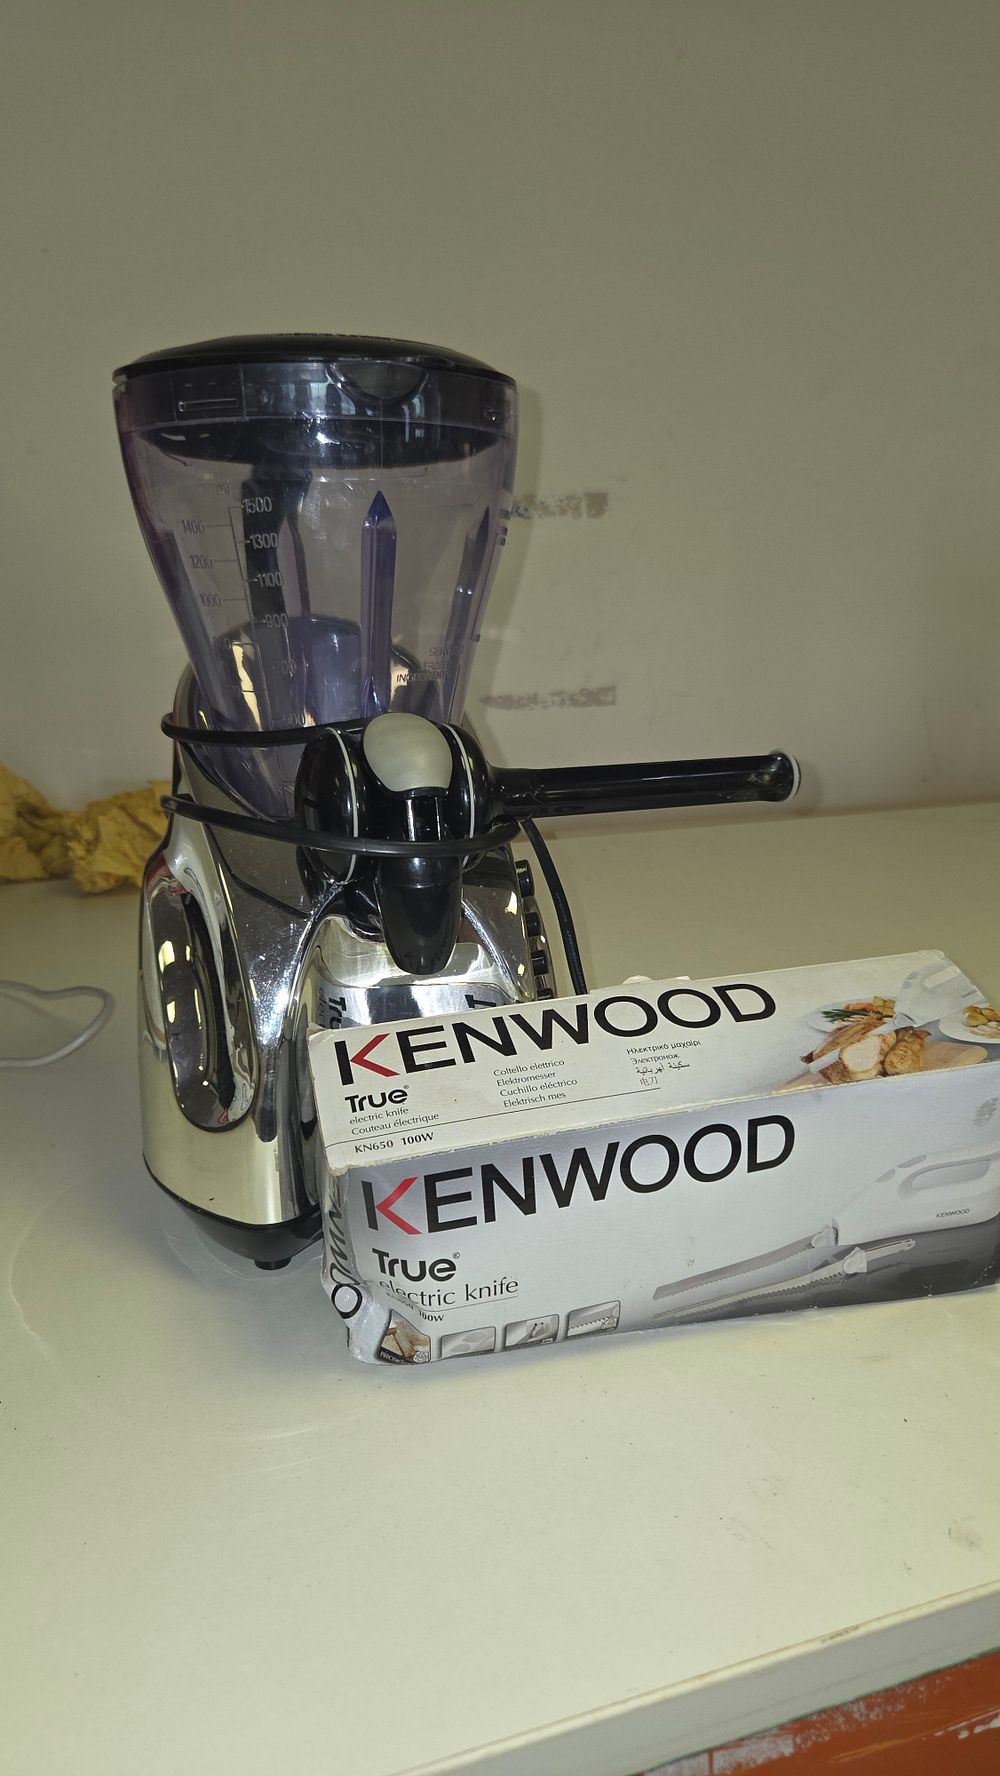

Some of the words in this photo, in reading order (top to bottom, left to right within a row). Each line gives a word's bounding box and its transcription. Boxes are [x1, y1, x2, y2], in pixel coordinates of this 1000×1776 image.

[244, 497, 273, 514] 1500
[182, 520, 206, 534] 1400
[249, 533, 279, 549] 1300
[190, 555, 213, 569] 1200
[257, 572, 284, 587] 1100
[200, 593, 222, 608] 1000
[265, 613, 288, 628] 900
[334, 983, 776, 1086] KENWOOD
[493, 1064, 528, 1077] Coltello
[529, 1059, 565, 1071] elettrico
[496, 1071, 556, 1087] Elektromesser
[500, 1083, 538, 1097] Cuchillo
[540, 1078, 578, 1090] eléctrico
[344, 1089, 408, 1114] True
[503, 1095, 546, 1108] Elektrisch
[547, 1091, 566, 1100] mes
[349, 1112, 384, 1125] electric
[385, 1107, 409, 1118] knife
[351, 1123, 391, 1136] Couteau
[393, 1113, 440, 1128] électrique
[354, 1139, 394, 1154] KN650
[401, 1132, 434, 1146] 100W
[361, 1115, 795, 1235] KENWOOD
[935, 1208, 970, 1218] KENWOOD
[371, 1247, 457, 1282] True
[379, 1280, 456, 1307] electric
[465, 1276, 519, 1301] knife
